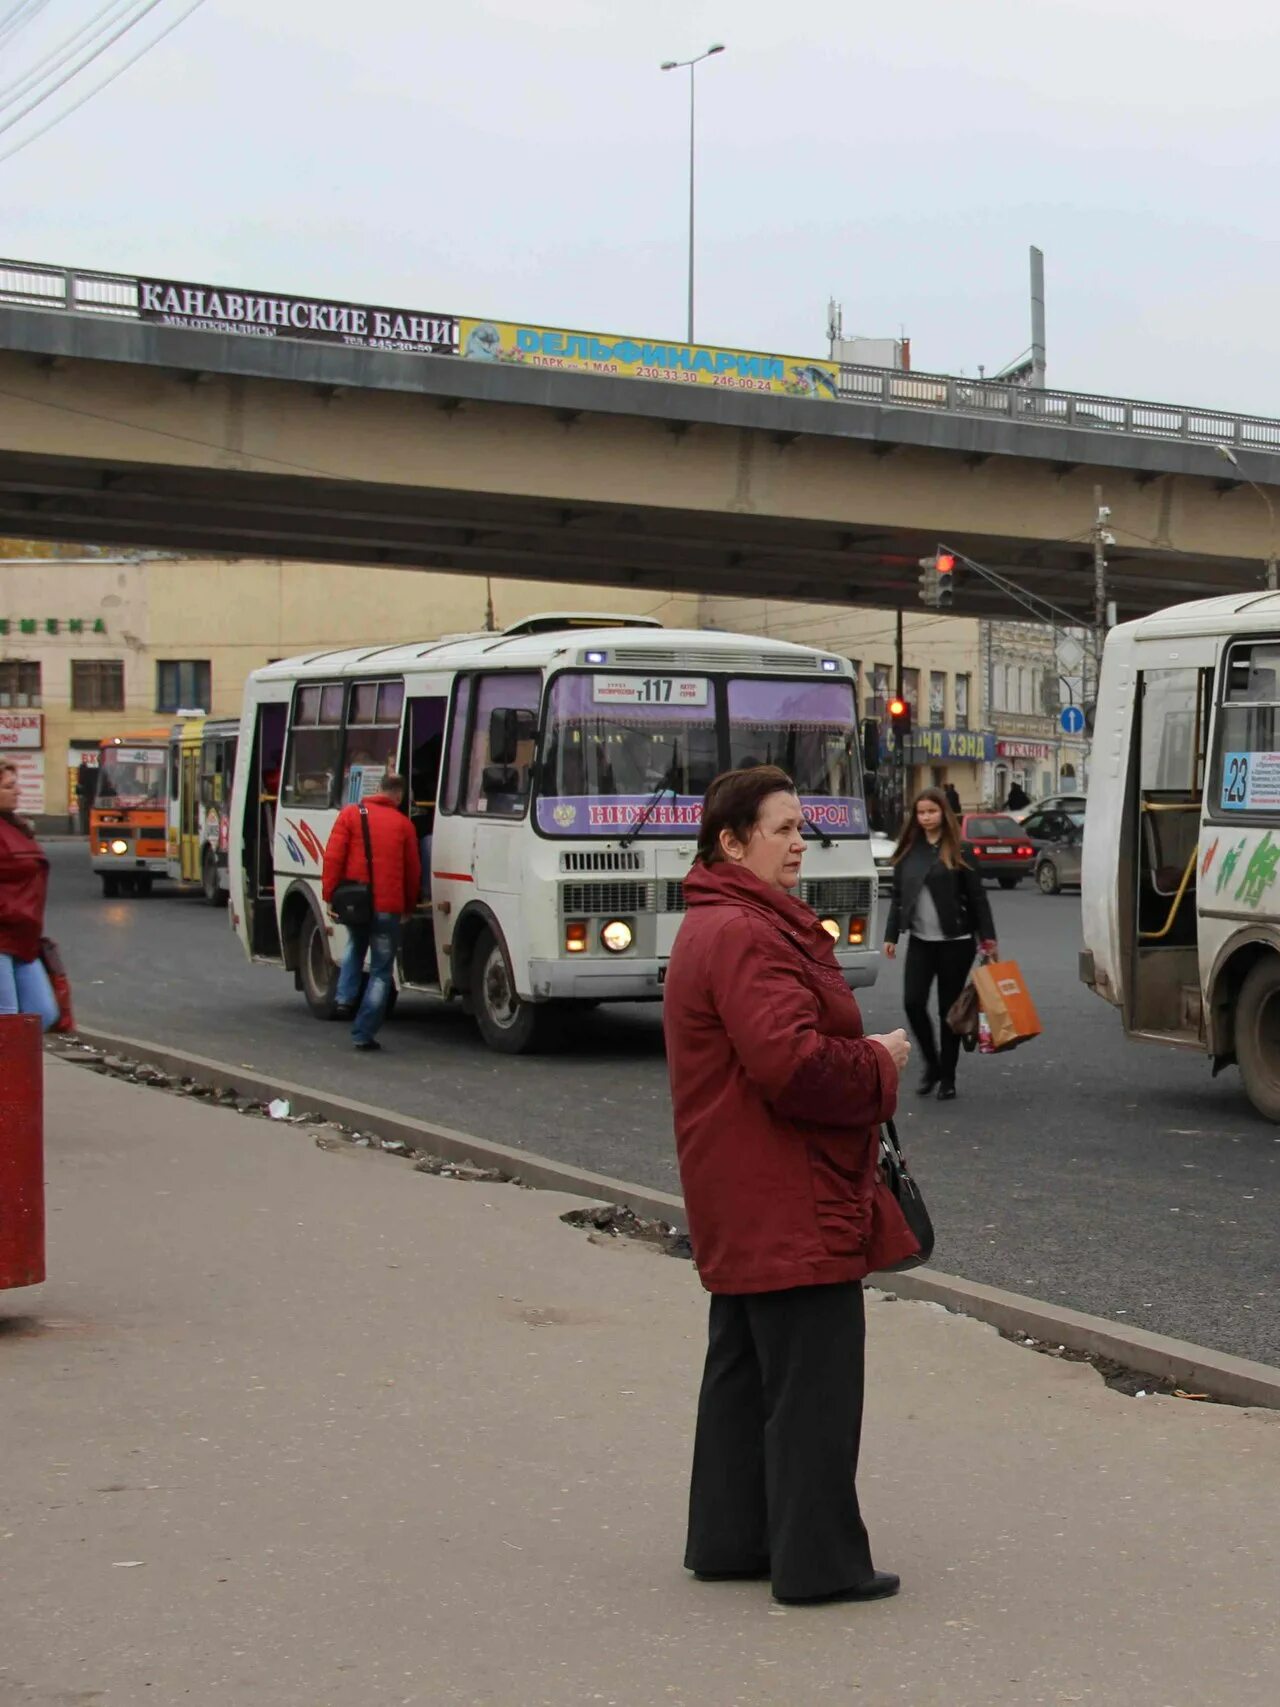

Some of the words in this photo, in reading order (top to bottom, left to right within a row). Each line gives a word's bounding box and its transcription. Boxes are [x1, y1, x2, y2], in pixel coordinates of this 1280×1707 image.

[140, 283, 368, 335] КАНАВИНСКИЕ
[373, 312, 451, 345] БАНИ
[162, 315, 188, 328] МЫ
[532, 356, 564, 368] ПАРК
[592, 362, 617, 373] МАЯ
[636, 367, 697, 382] 230-33-30
[713, 376, 771, 390] 246-00-24
[949, 734, 985, 760] ХЭНД
[589, 802, 704, 825] НИЖНИЙ
[801, 804, 849, 826] ОРОД
